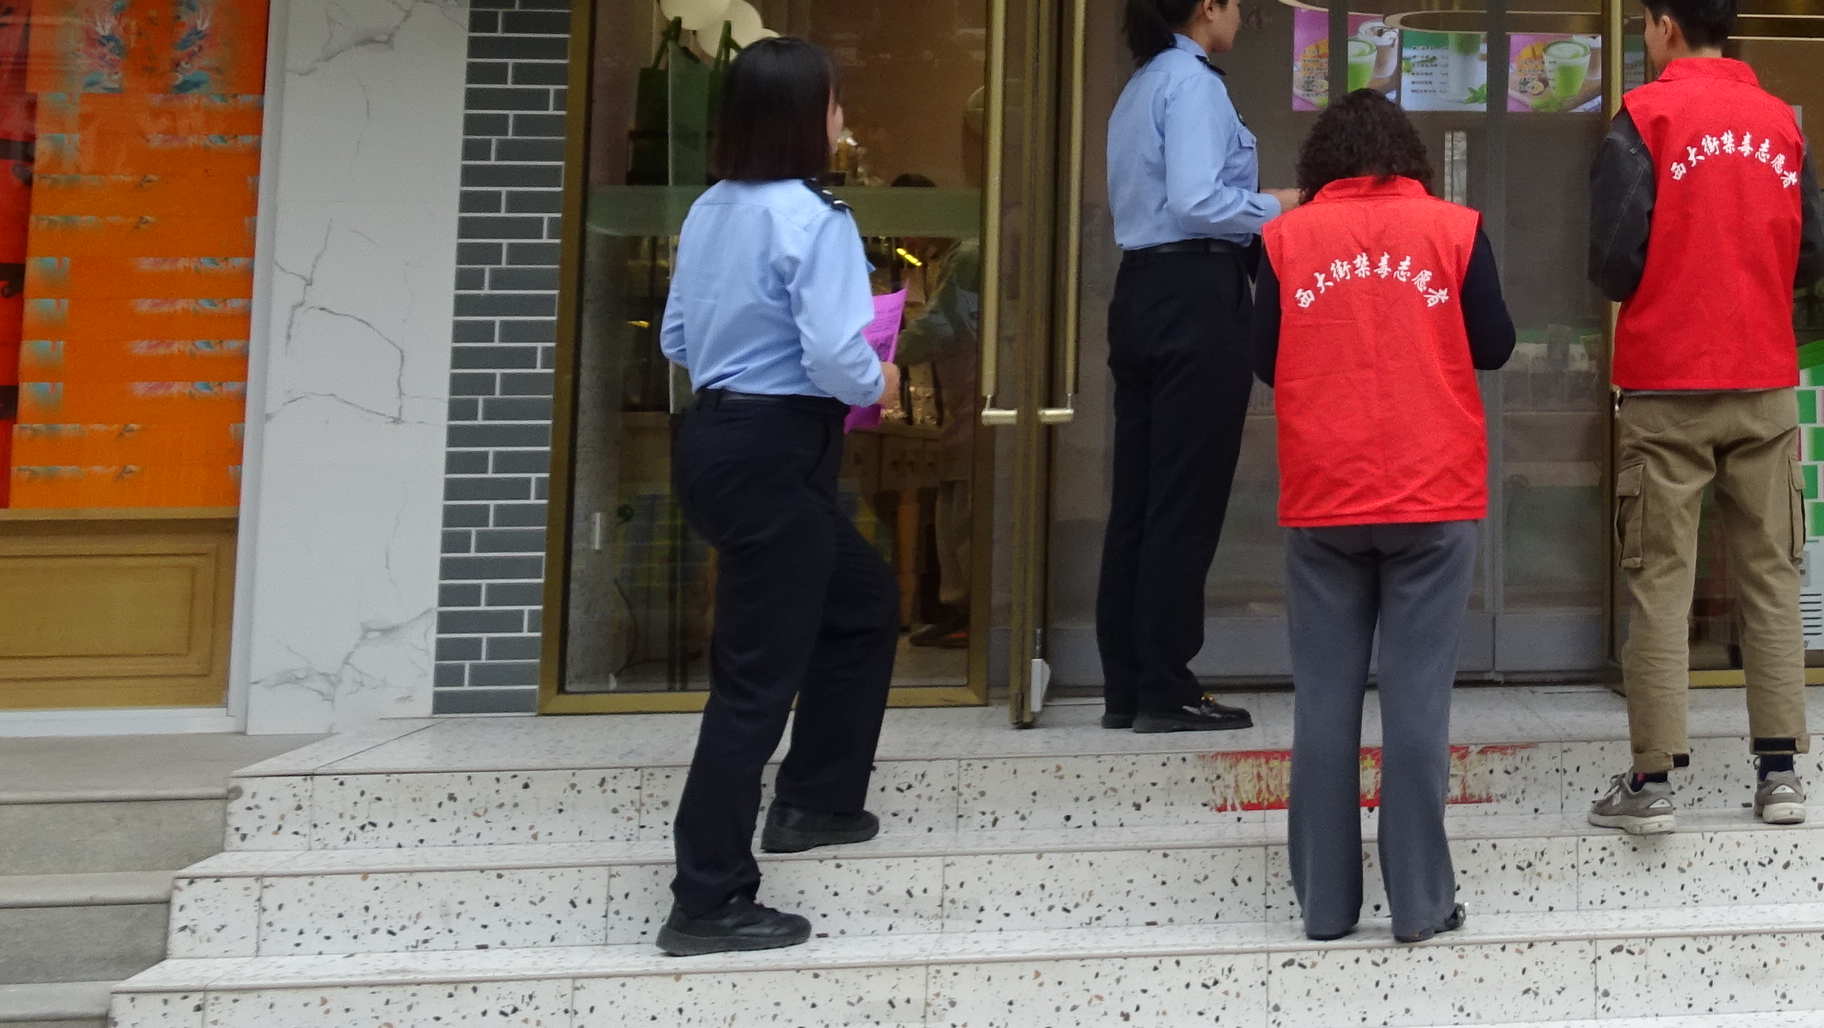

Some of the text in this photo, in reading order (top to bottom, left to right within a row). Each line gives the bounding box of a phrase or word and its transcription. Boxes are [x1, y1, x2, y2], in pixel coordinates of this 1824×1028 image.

[1670, 129, 1798, 189] 西大街禁毒志愿者
[1294, 251, 1449, 308] 西大街禁毒志愿者
